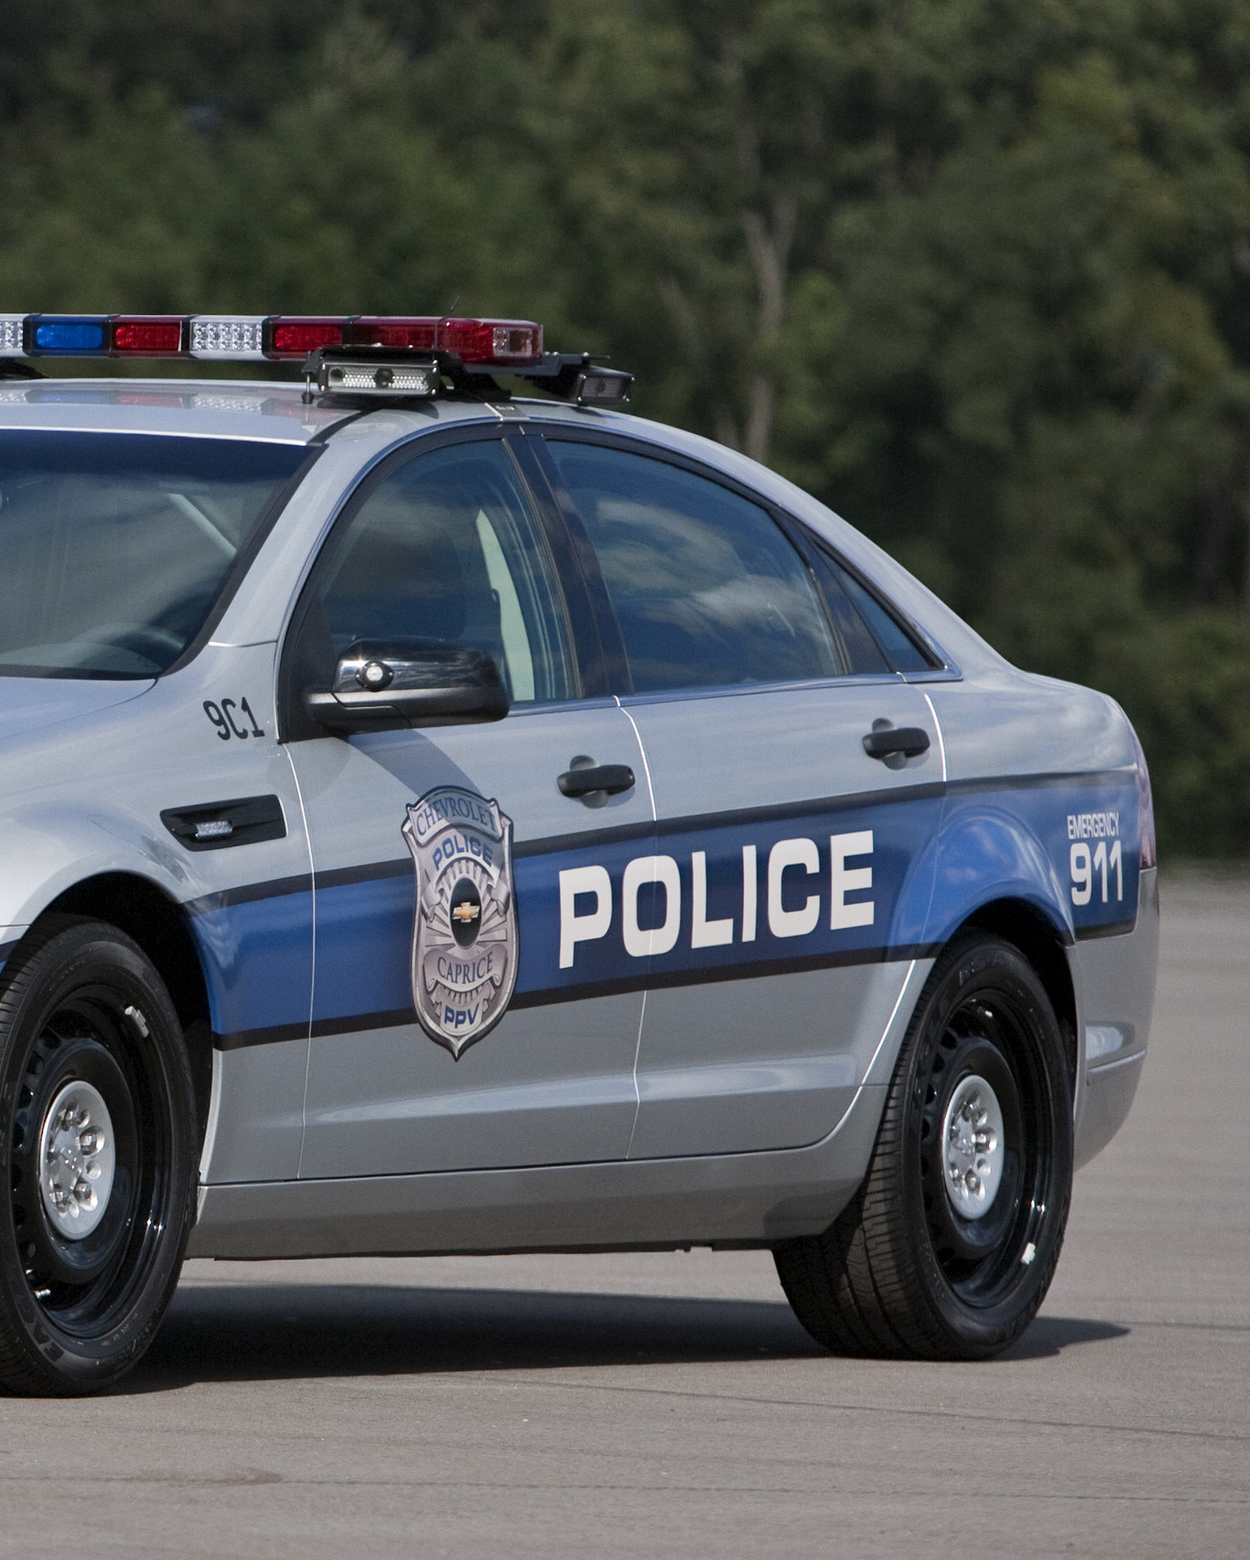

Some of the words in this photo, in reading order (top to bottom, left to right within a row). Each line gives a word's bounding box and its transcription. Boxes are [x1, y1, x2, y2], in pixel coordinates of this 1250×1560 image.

[203, 697, 265, 740] 9C1
[416, 798, 496, 837] CHEVROLET
[1067, 812, 1119, 839] EMERGENCY
[432, 834, 493, 871] POLICE
[1070, 840, 1123, 905] 911
[558, 830, 875, 969] POLICE
[437, 951, 494, 985] CAPRICE
[444, 1004, 482, 1029] PPV
